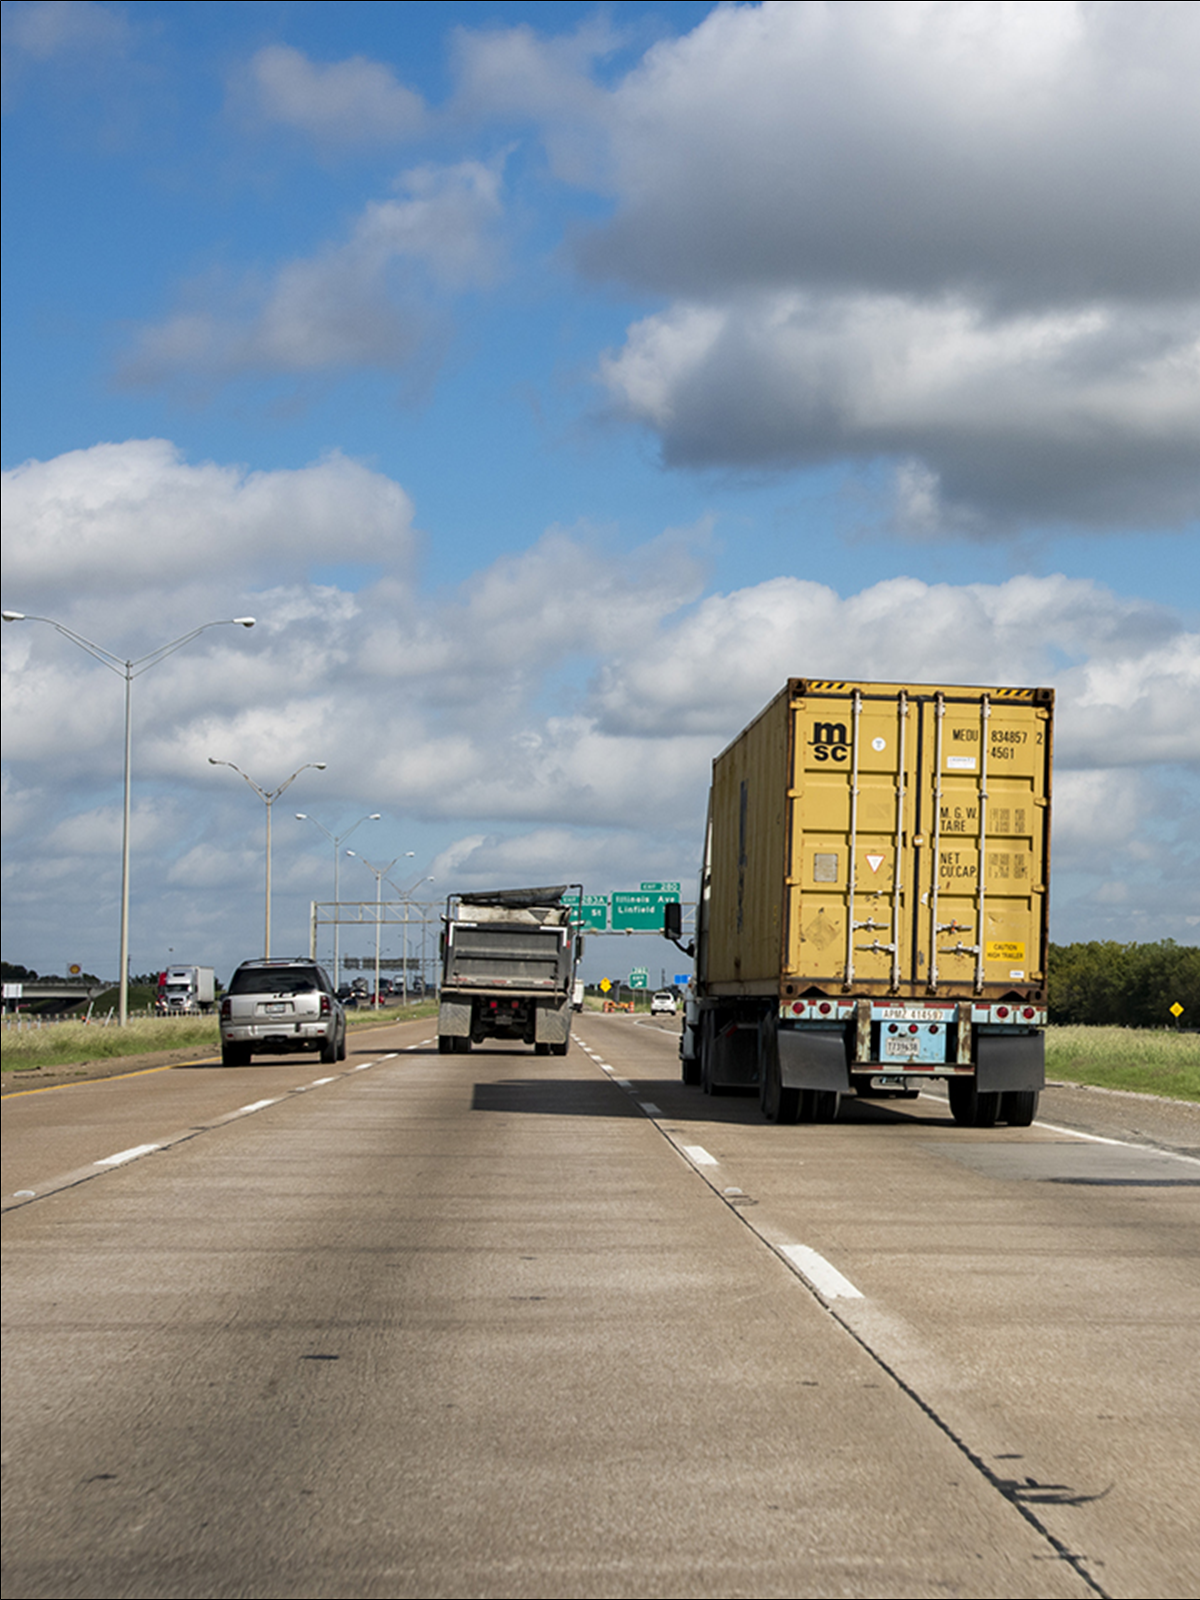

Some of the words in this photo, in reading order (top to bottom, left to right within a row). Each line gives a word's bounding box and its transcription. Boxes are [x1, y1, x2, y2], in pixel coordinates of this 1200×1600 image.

[953, 729, 978, 742] MEDU
[991, 730, 1028, 744] 834857
[1036, 732, 1043, 745] 2
[990, 747, 1015, 759] 45G1
[941, 820, 966, 832] TARE
[941, 852, 960, 864] NET
[591, 909, 602, 917] St
[617, 906, 655, 914] Linfield
